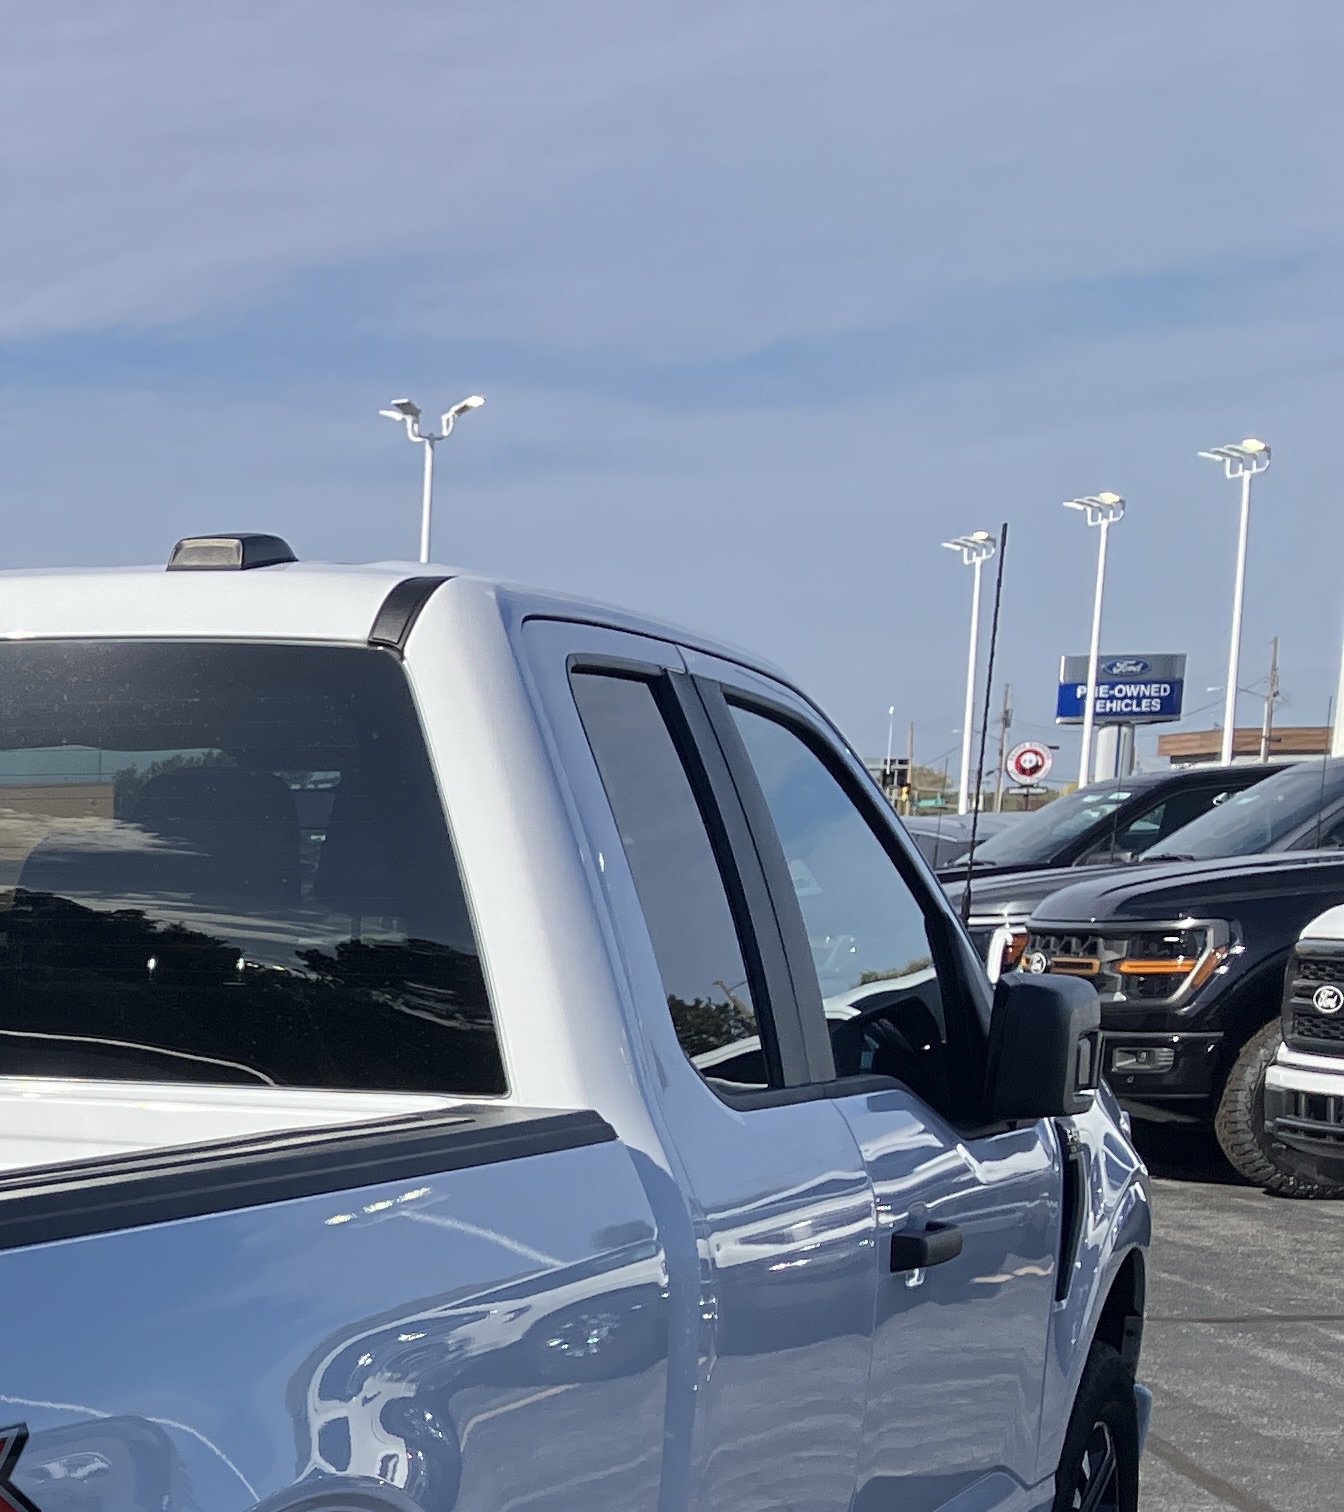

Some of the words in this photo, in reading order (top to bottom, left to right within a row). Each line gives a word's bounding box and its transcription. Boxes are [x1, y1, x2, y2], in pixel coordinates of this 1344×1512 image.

[1112, 660, 1143, 674] Ford
[1076, 683, 1170, 698] PE-OWNED
[1087, 699, 1161, 713] EHICLES
